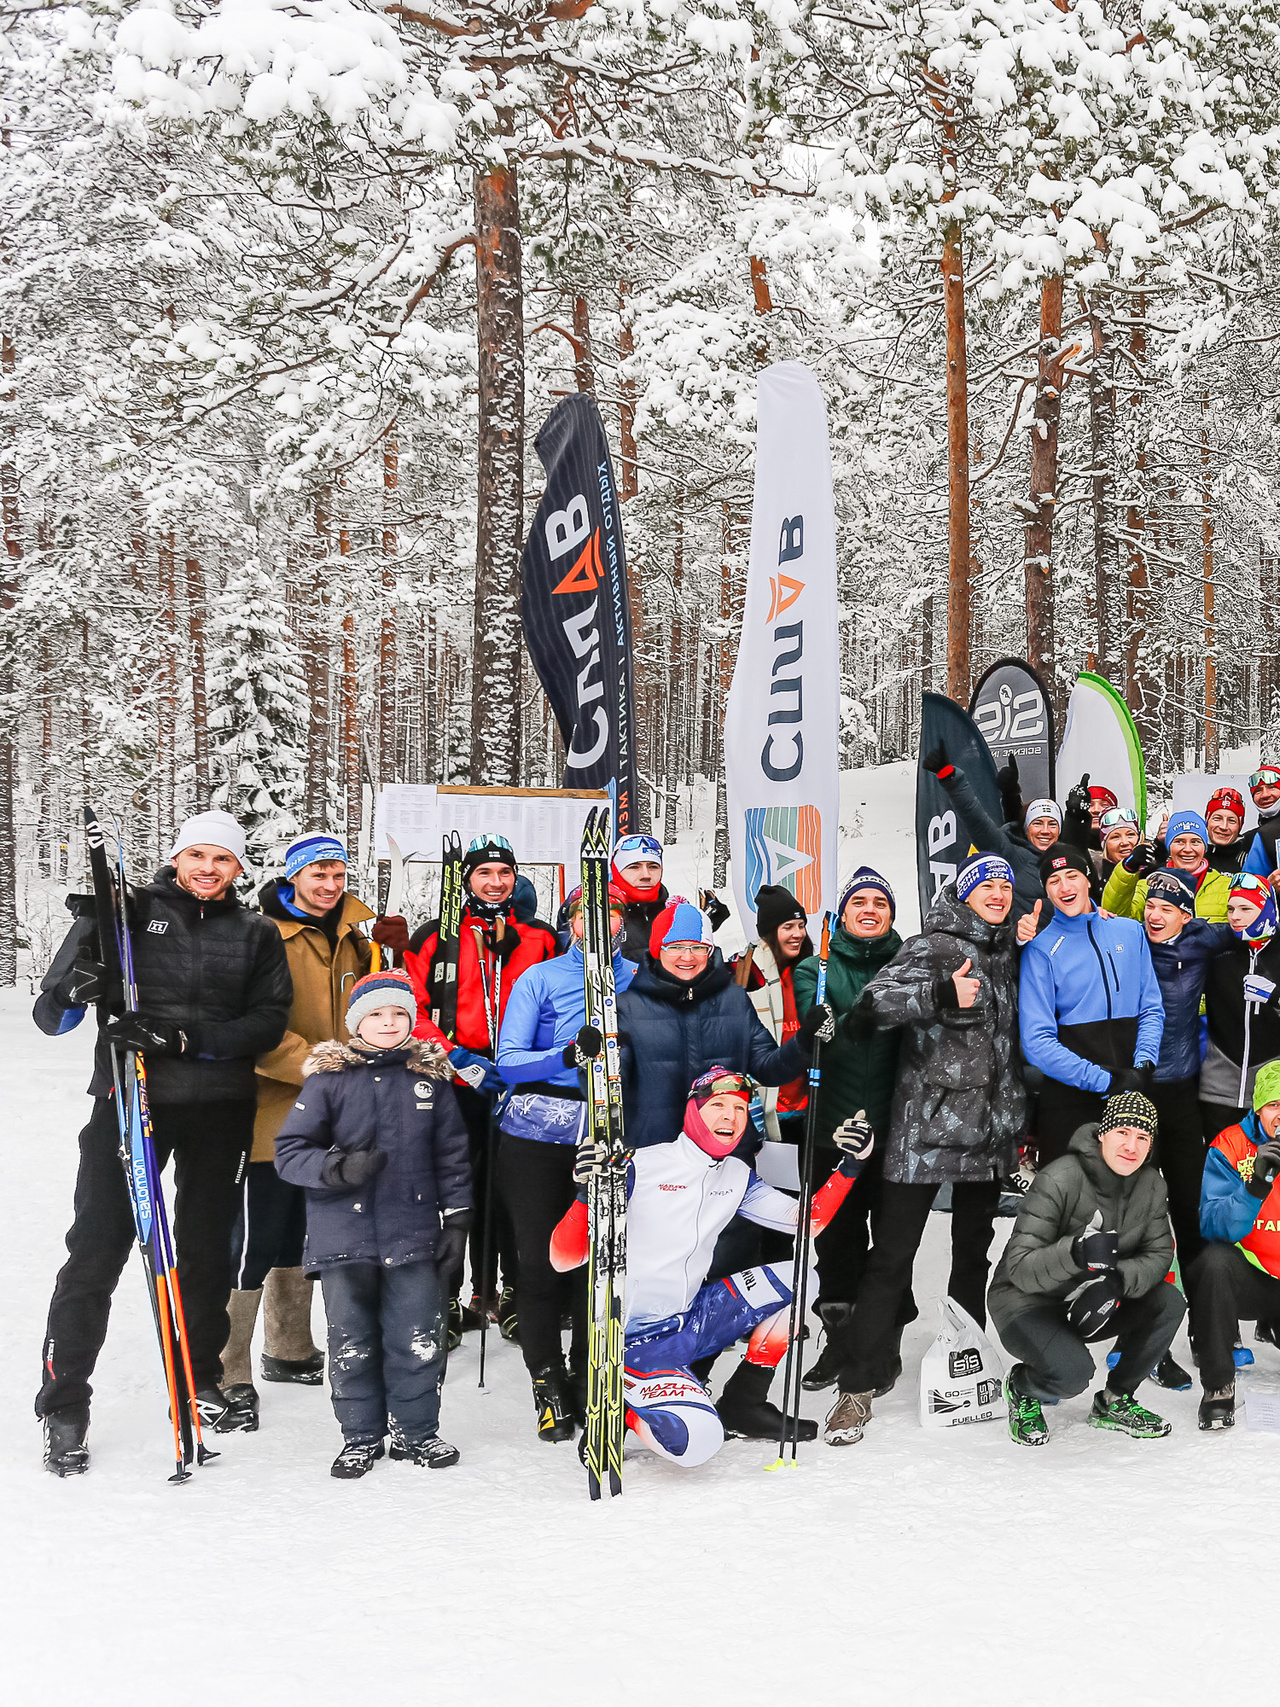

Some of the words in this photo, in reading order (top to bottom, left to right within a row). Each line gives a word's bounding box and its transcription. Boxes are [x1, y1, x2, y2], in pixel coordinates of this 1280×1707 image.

[597, 461, 613, 530] ОТДЫХ
[606, 535, 625, 646] АКТИВНЫЙ
[545, 493, 609, 769] СПЛАВ
[618, 672, 629, 770] ТАКТИКА
[618, 790, 630, 835] ИЗМ
[440, 864, 452, 942] FISCHER
[451, 860, 462, 938] FISCHER
[985, 871, 1009, 880] 2021
[945, 1390, 960, 1398] GO
[952, 1410, 993, 1425] FUELLED
